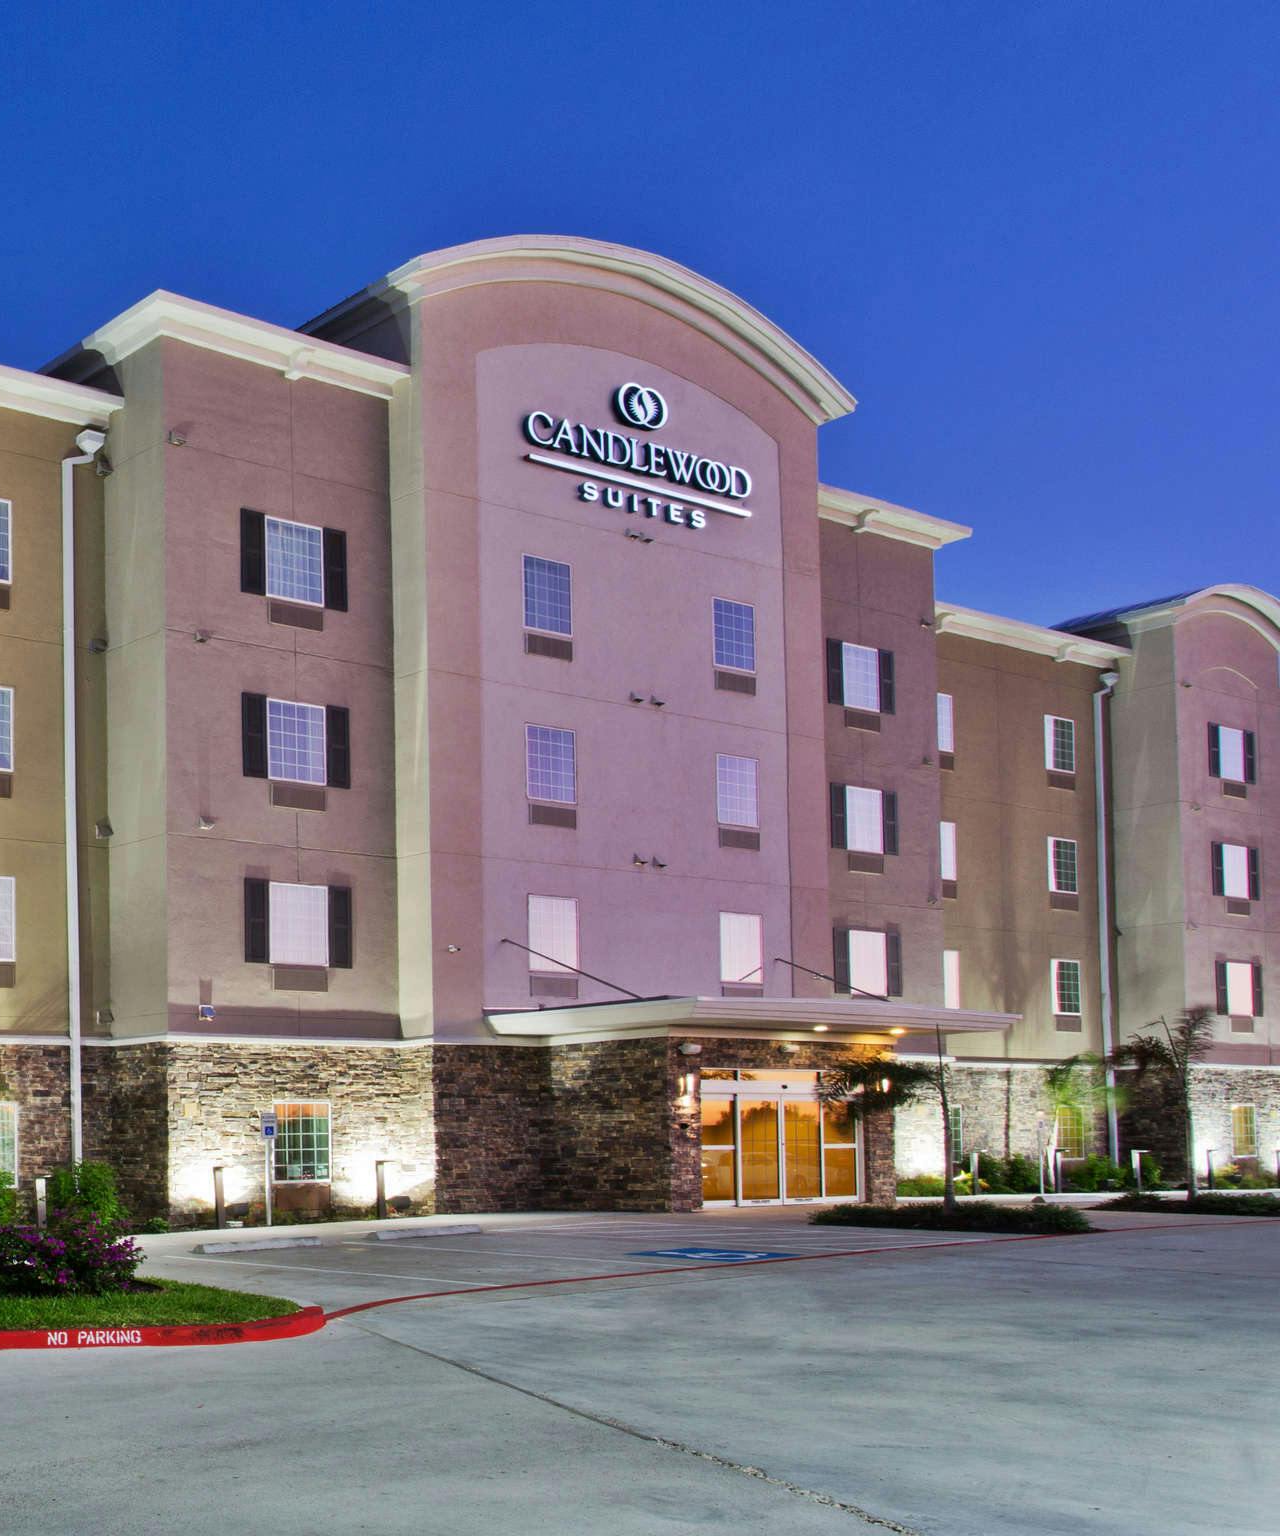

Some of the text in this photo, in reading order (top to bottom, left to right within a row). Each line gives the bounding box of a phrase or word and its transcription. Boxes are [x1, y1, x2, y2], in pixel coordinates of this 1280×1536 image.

[524, 411, 752, 498] CANDLEWOOD
[580, 481, 706, 528] SUITES
[47, 1330, 142, 1346] NO PARKING
